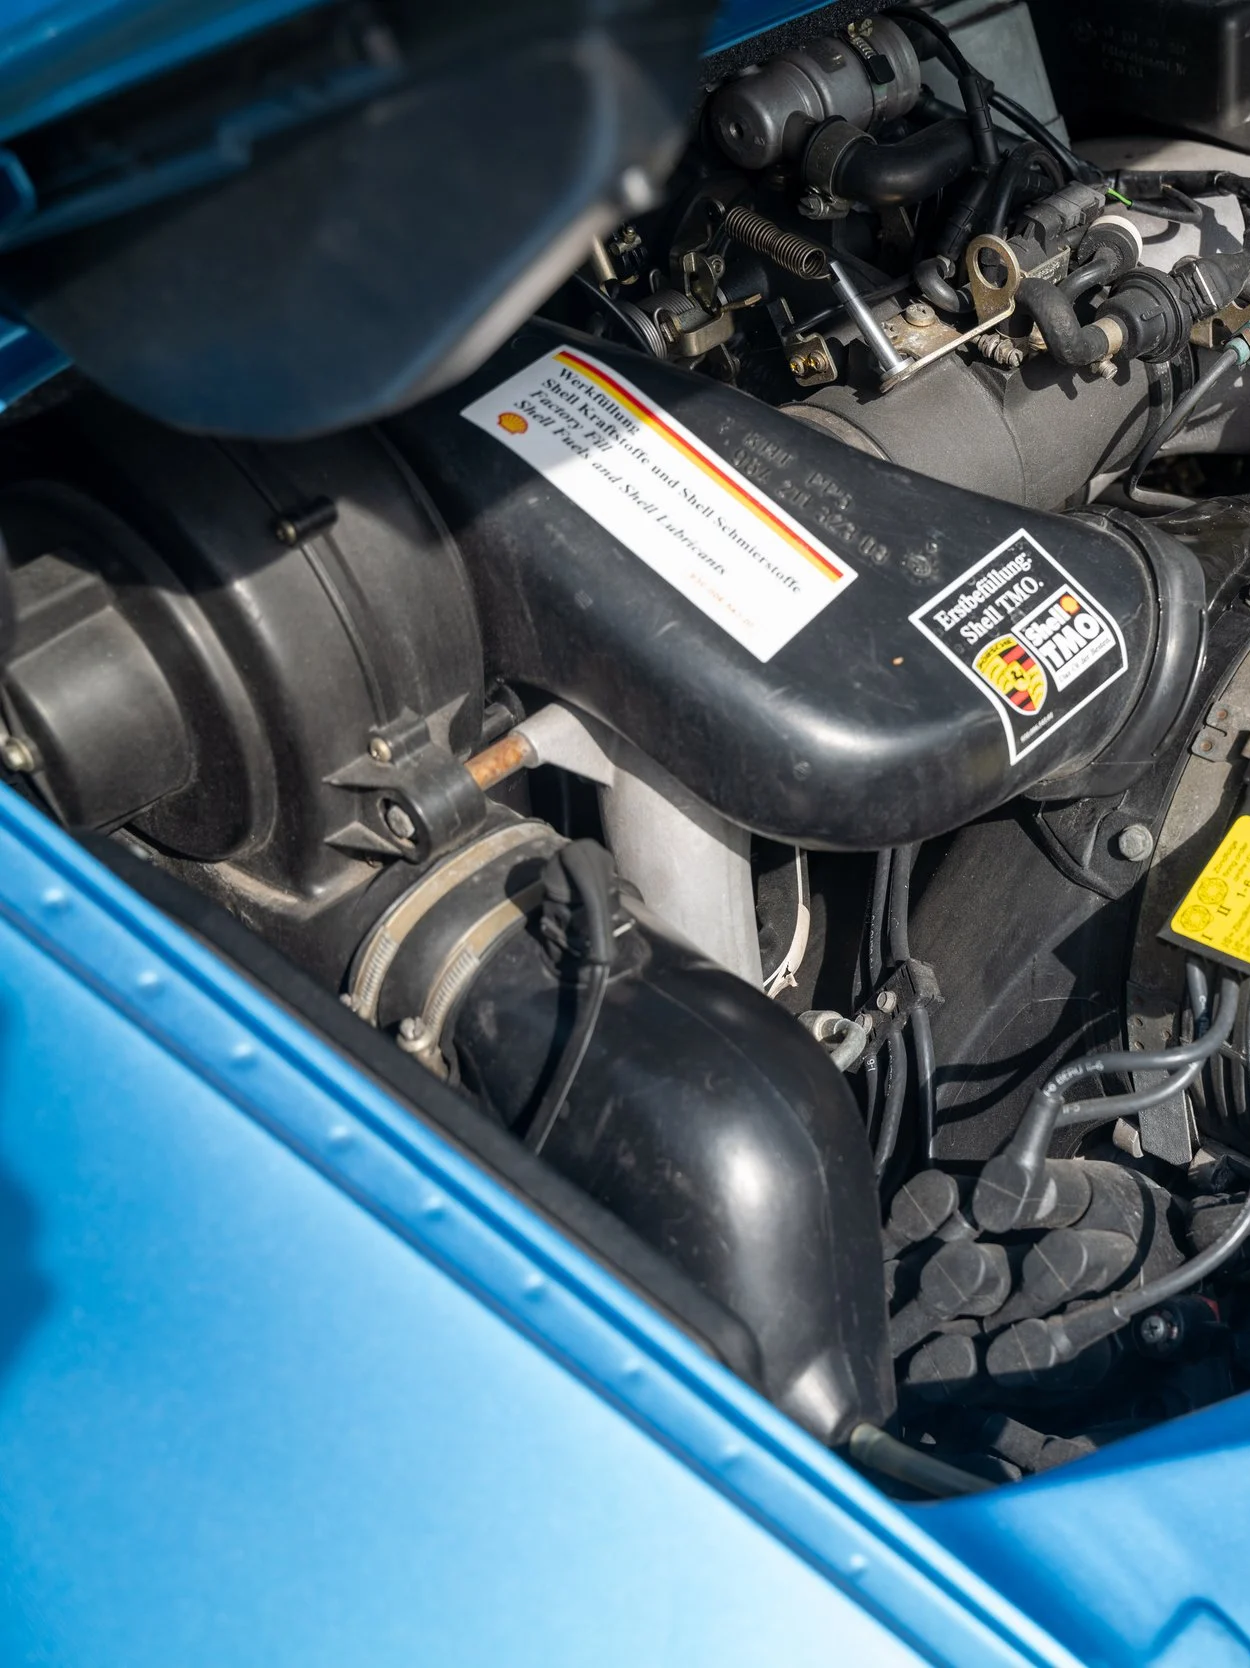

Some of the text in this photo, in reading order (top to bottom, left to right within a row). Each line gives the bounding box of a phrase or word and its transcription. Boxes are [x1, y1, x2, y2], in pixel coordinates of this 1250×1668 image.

[529, 389, 613, 454] Factory Fill
[559, 367, 640, 434] Werkfüllung
[513, 399, 727, 576] Shell Fuels and Shell Lubricants
[541, 378, 802, 594] Shell Kraftstoffe und Shell Schmierstoffe
[933, 552, 1032, 631] Erstbefüllung:
[960, 576, 1044, 644] Shell TMO.
[1025, 603, 1071, 647] Shell
[1036, 613, 1100, 668] TMO
